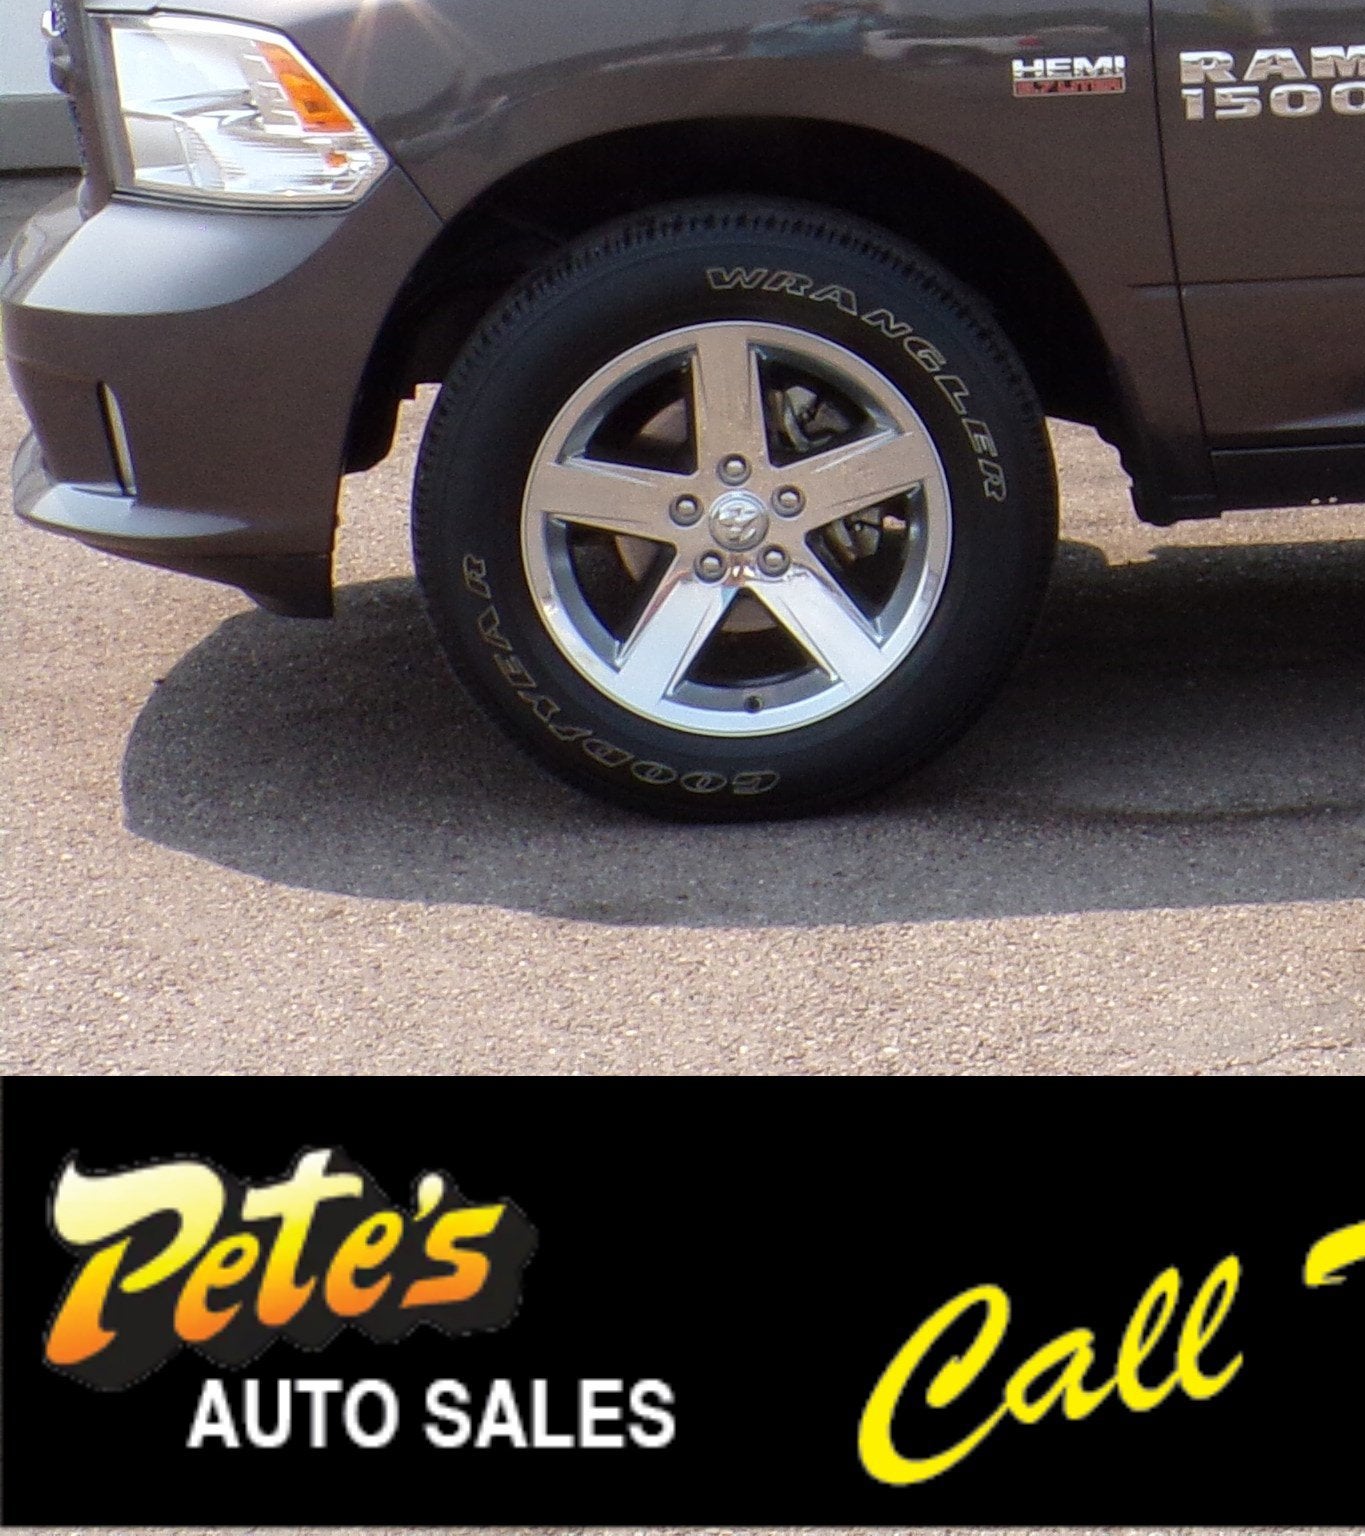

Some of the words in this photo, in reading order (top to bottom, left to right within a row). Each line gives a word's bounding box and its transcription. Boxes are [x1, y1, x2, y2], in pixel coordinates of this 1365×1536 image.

[1012, 55, 1126, 79] HEMI
[706, 266, 1006, 503] WRANGLER
[463, 554, 780, 794] GOODYEAR
